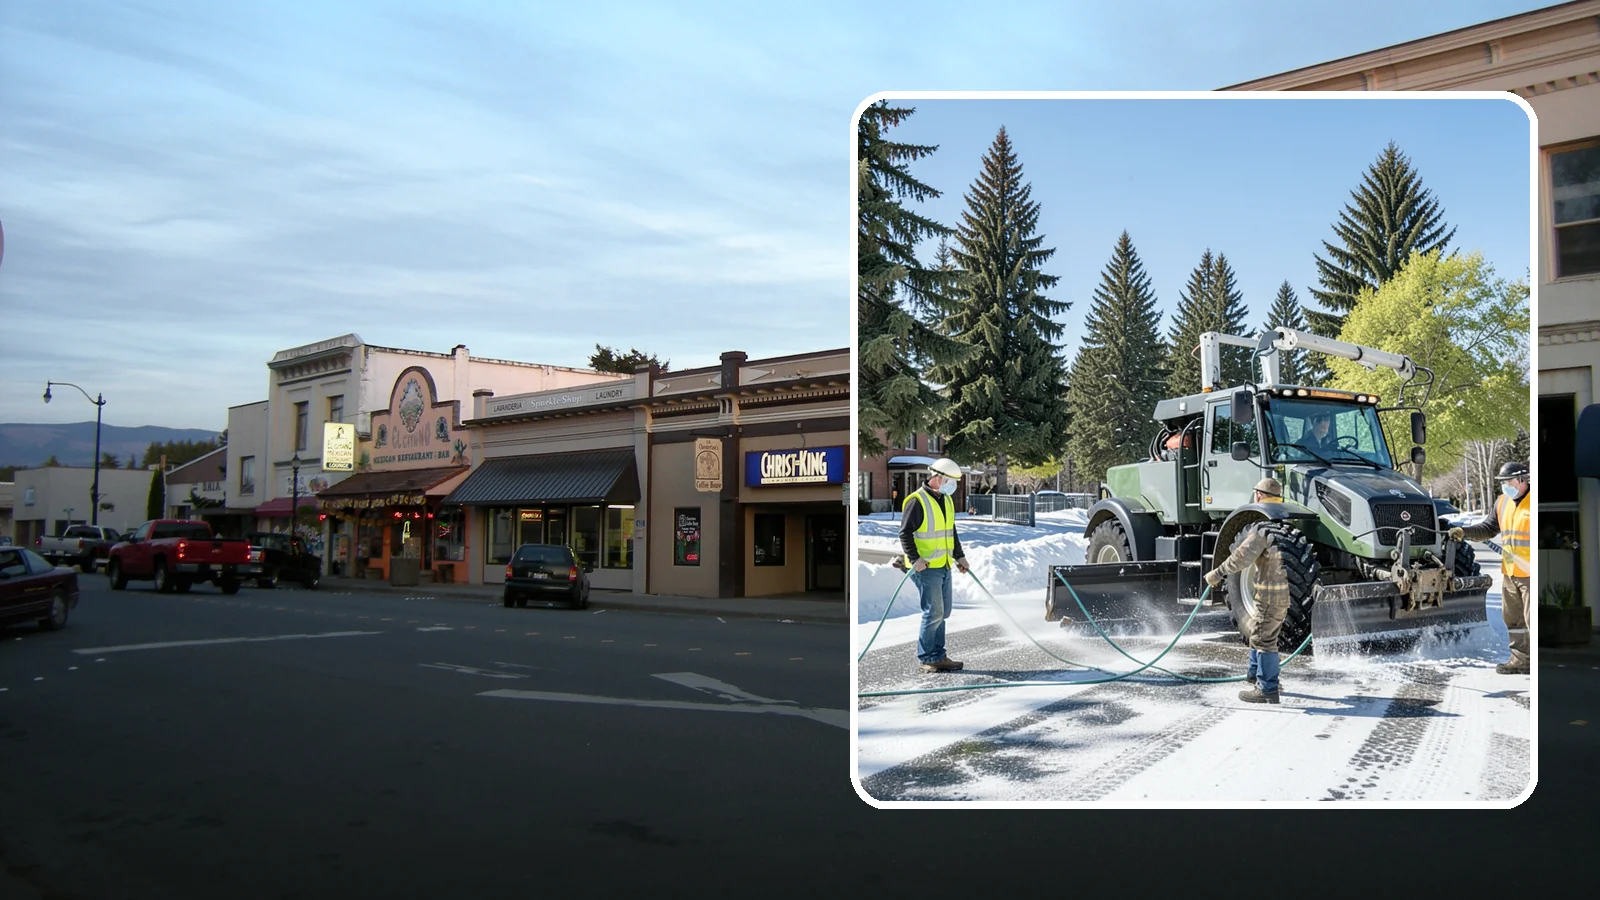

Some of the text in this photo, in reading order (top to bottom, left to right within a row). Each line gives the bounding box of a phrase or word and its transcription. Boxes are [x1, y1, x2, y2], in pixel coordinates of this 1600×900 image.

[493, 388, 624, 413] LAVANDERIA Sparkle Shop LAUNDRY
[373, 450, 451, 464] MEXICAN RESTAURANT BAR
[761, 450, 827, 478] CHRIST KING
